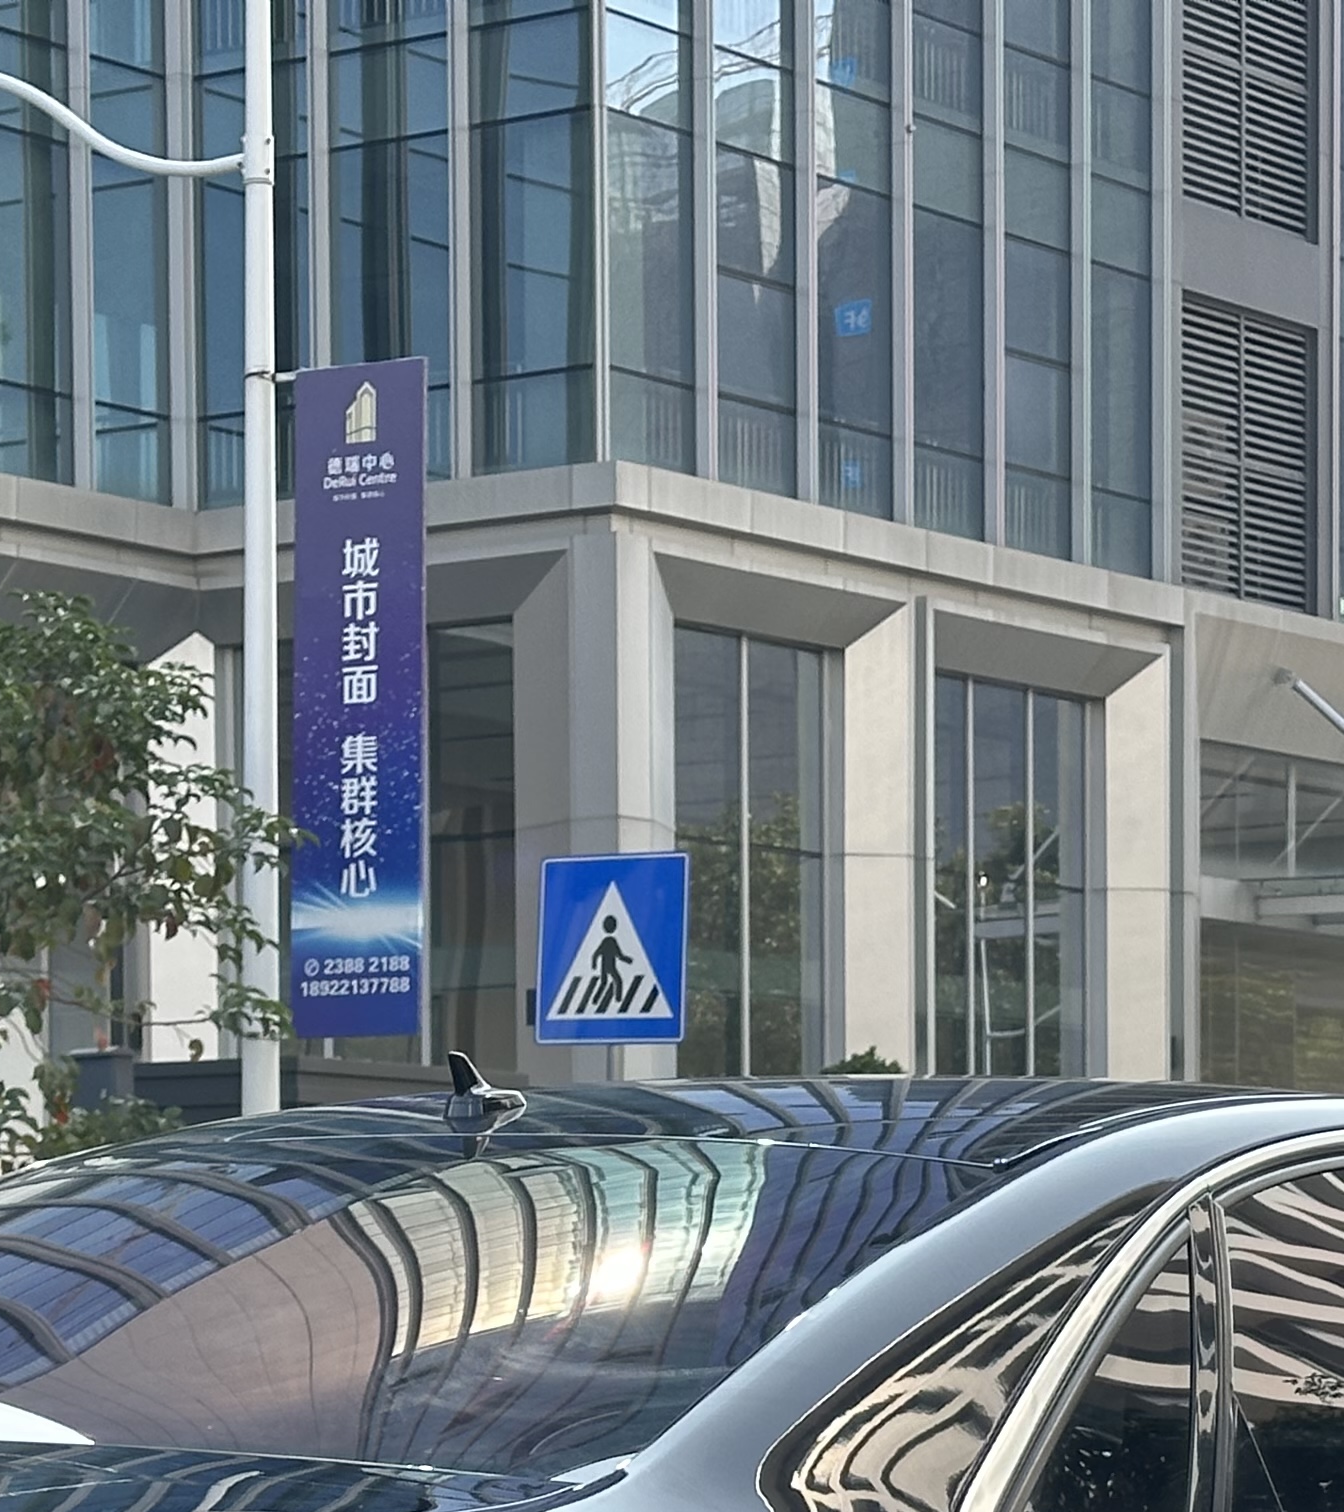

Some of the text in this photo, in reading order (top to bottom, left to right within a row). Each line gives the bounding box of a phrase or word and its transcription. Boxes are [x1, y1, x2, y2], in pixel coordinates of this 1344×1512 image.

[340, 537, 379, 705] 城市封面
[339, 733, 378, 898] 集群核心
[301, 977, 410, 997] 18922137788
[324, 955, 410, 974] 2388 2188
